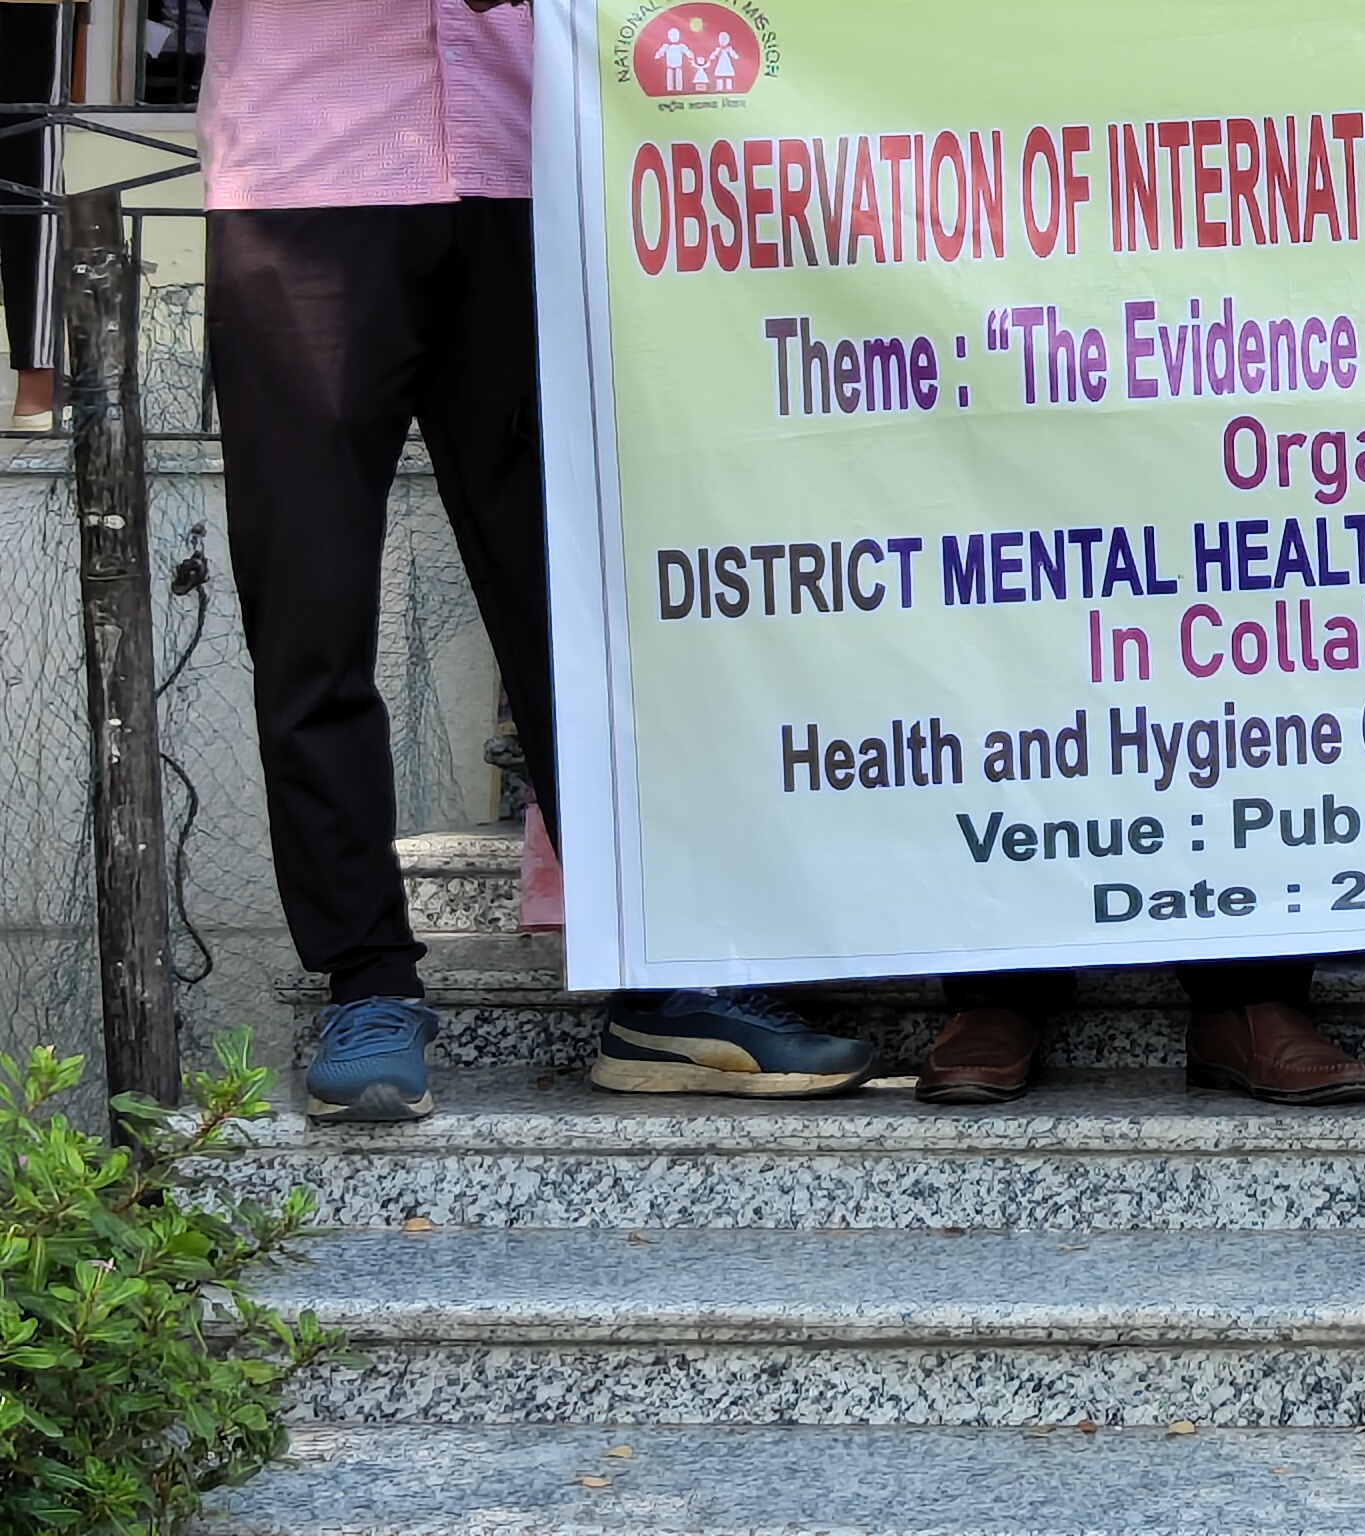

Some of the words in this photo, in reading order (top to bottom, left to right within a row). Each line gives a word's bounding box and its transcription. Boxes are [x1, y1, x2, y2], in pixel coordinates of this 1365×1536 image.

[742, 1, 781, 78] MISSION
[631, 129, 1006, 276] OBSERVATION
[1022, 125, 1090, 259] OF
[765, 316, 938, 417] Theme
[1125, 296, 1357, 400] Evidence
[657, 537, 923, 620] DISTRICT
[942, 526, 1179, 606] MENTAL
[1089, 609, 1150, 683] In
[781, 717, 963, 793] Health
[984, 709, 1088, 781] and
[1109, 701, 1342, 793] Hygiene
[957, 812, 1165, 863] Venue
[1233, 794, 1361, 849] Pub
[1093, 880, 1258, 924] Date
